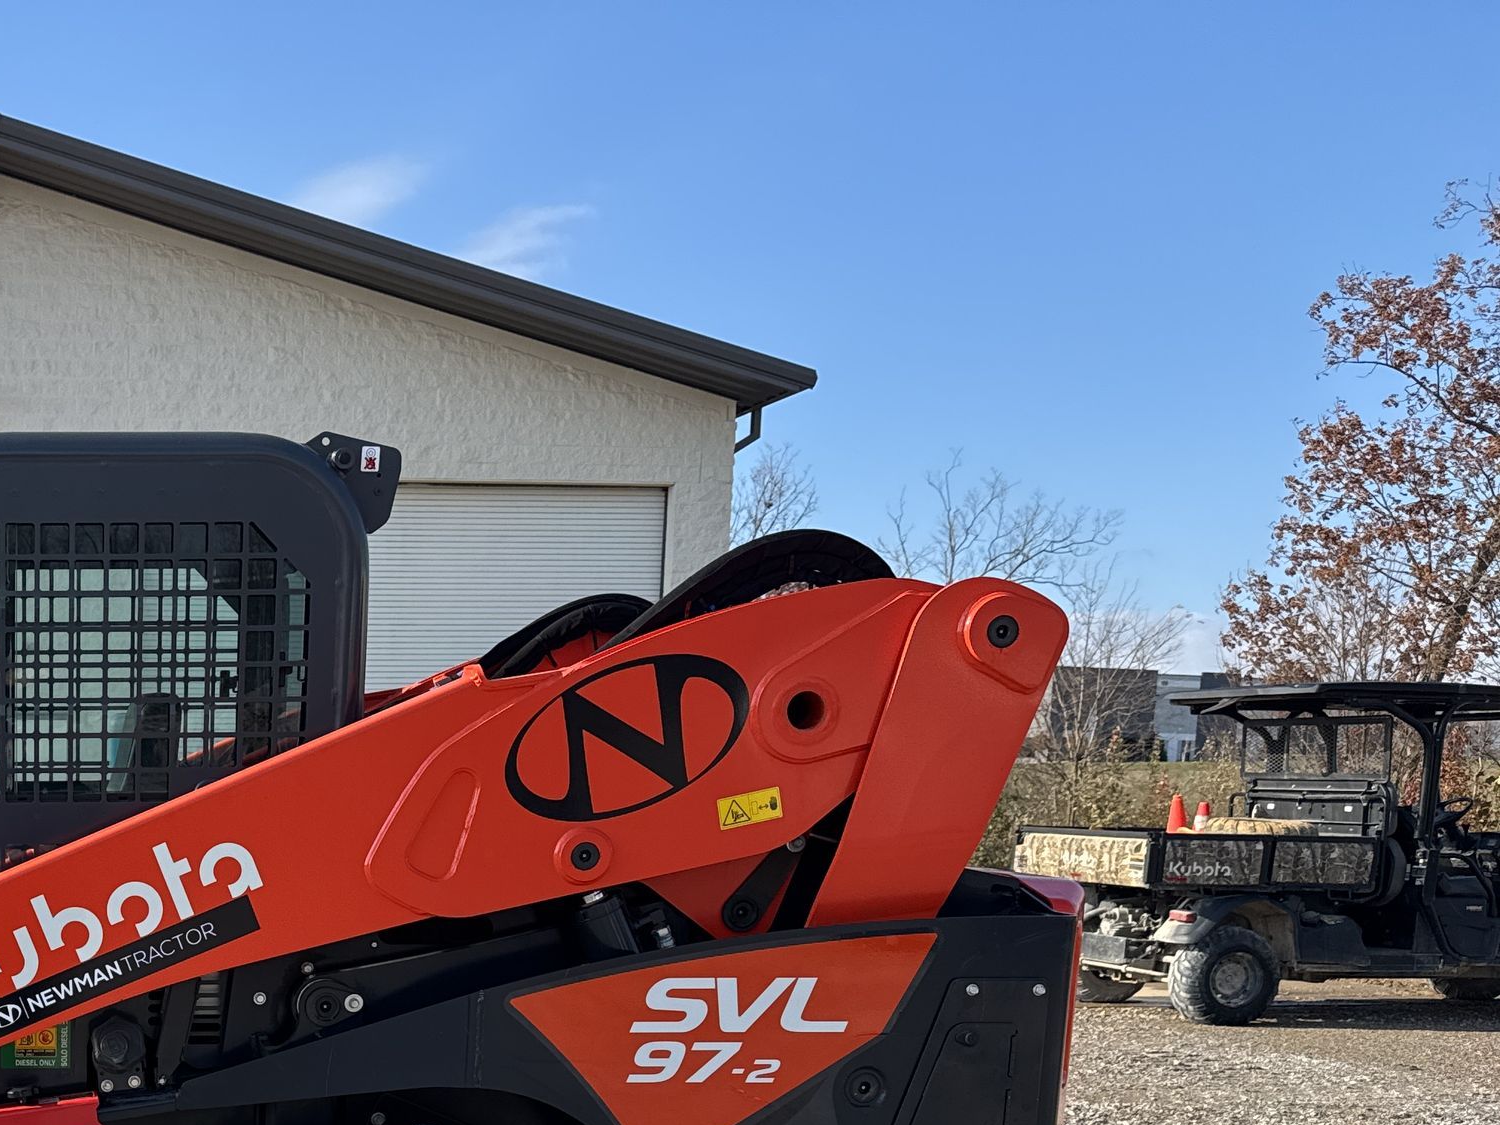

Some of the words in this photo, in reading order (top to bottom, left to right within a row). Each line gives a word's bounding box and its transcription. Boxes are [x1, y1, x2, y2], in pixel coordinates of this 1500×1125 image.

[1169, 861, 1231, 877] Kubota
[629, 977, 849, 1034] SVL
[625, 1041, 781, 1084] 97-2
